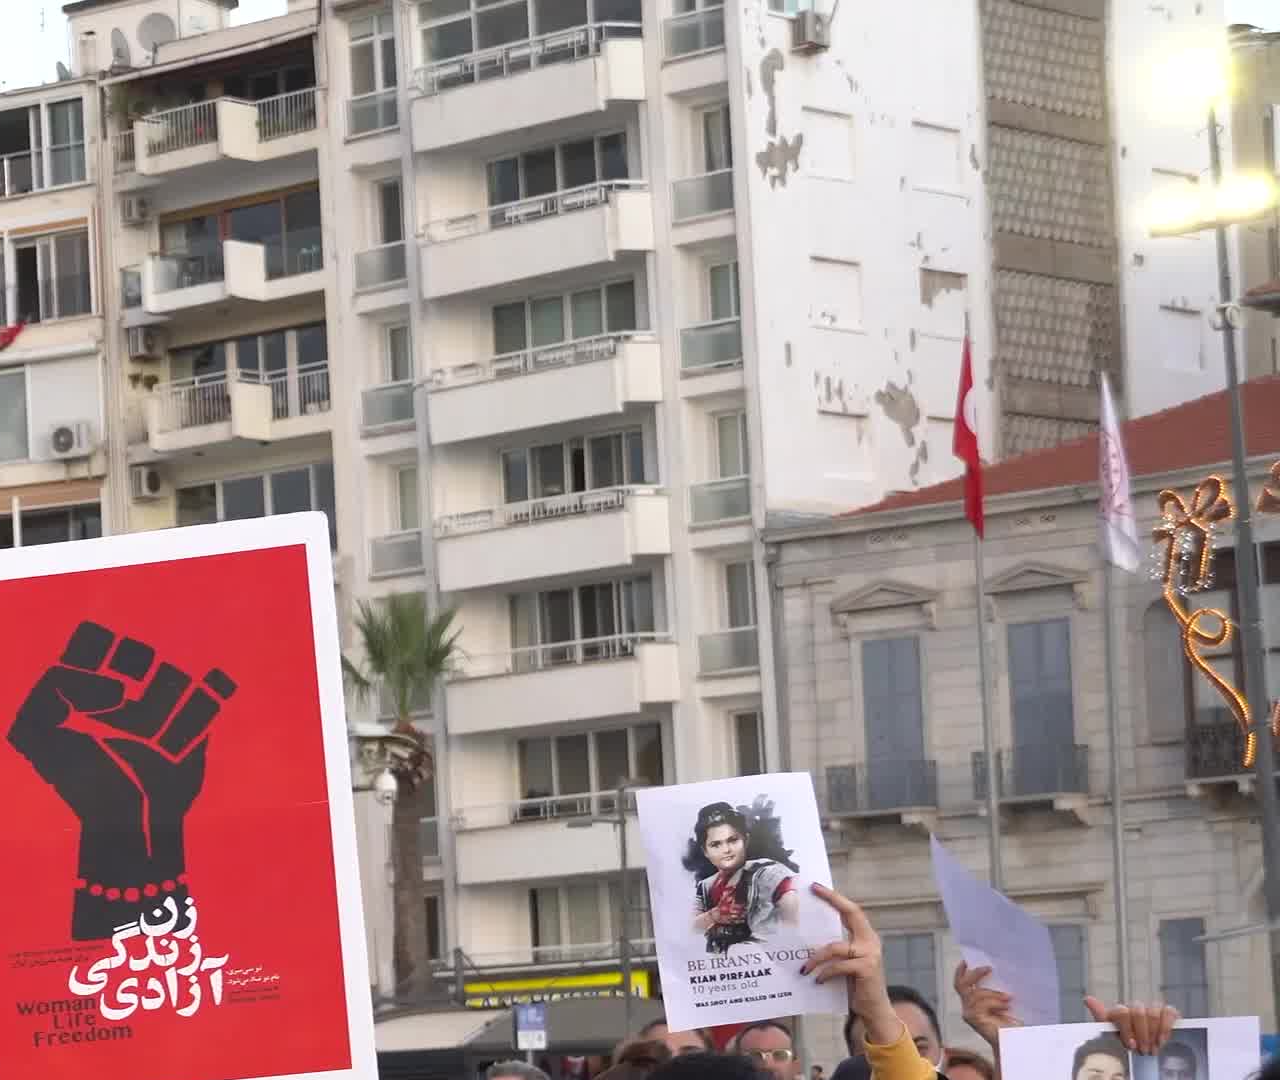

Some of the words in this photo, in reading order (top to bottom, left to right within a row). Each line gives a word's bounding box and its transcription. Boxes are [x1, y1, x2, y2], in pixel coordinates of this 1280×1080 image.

[139, 896, 198, 939] زن
[67, 921, 203, 996] زندگی
[688, 959, 707, 971] BE
[711, 952, 762, 969] IRAN'S
[765, 948, 816, 962] VOICE
[99, 953, 230, 1021] آزادی
[690, 975, 717, 984] KIAN
[720, 968, 772, 981] PIRFALAK
[692, 985, 704, 994] 10
[708, 983, 737, 995] years
[740, 979, 759, 990] old
[53, 1011, 96, 1031] Life
[33, 1023, 134, 1048] Freedom
